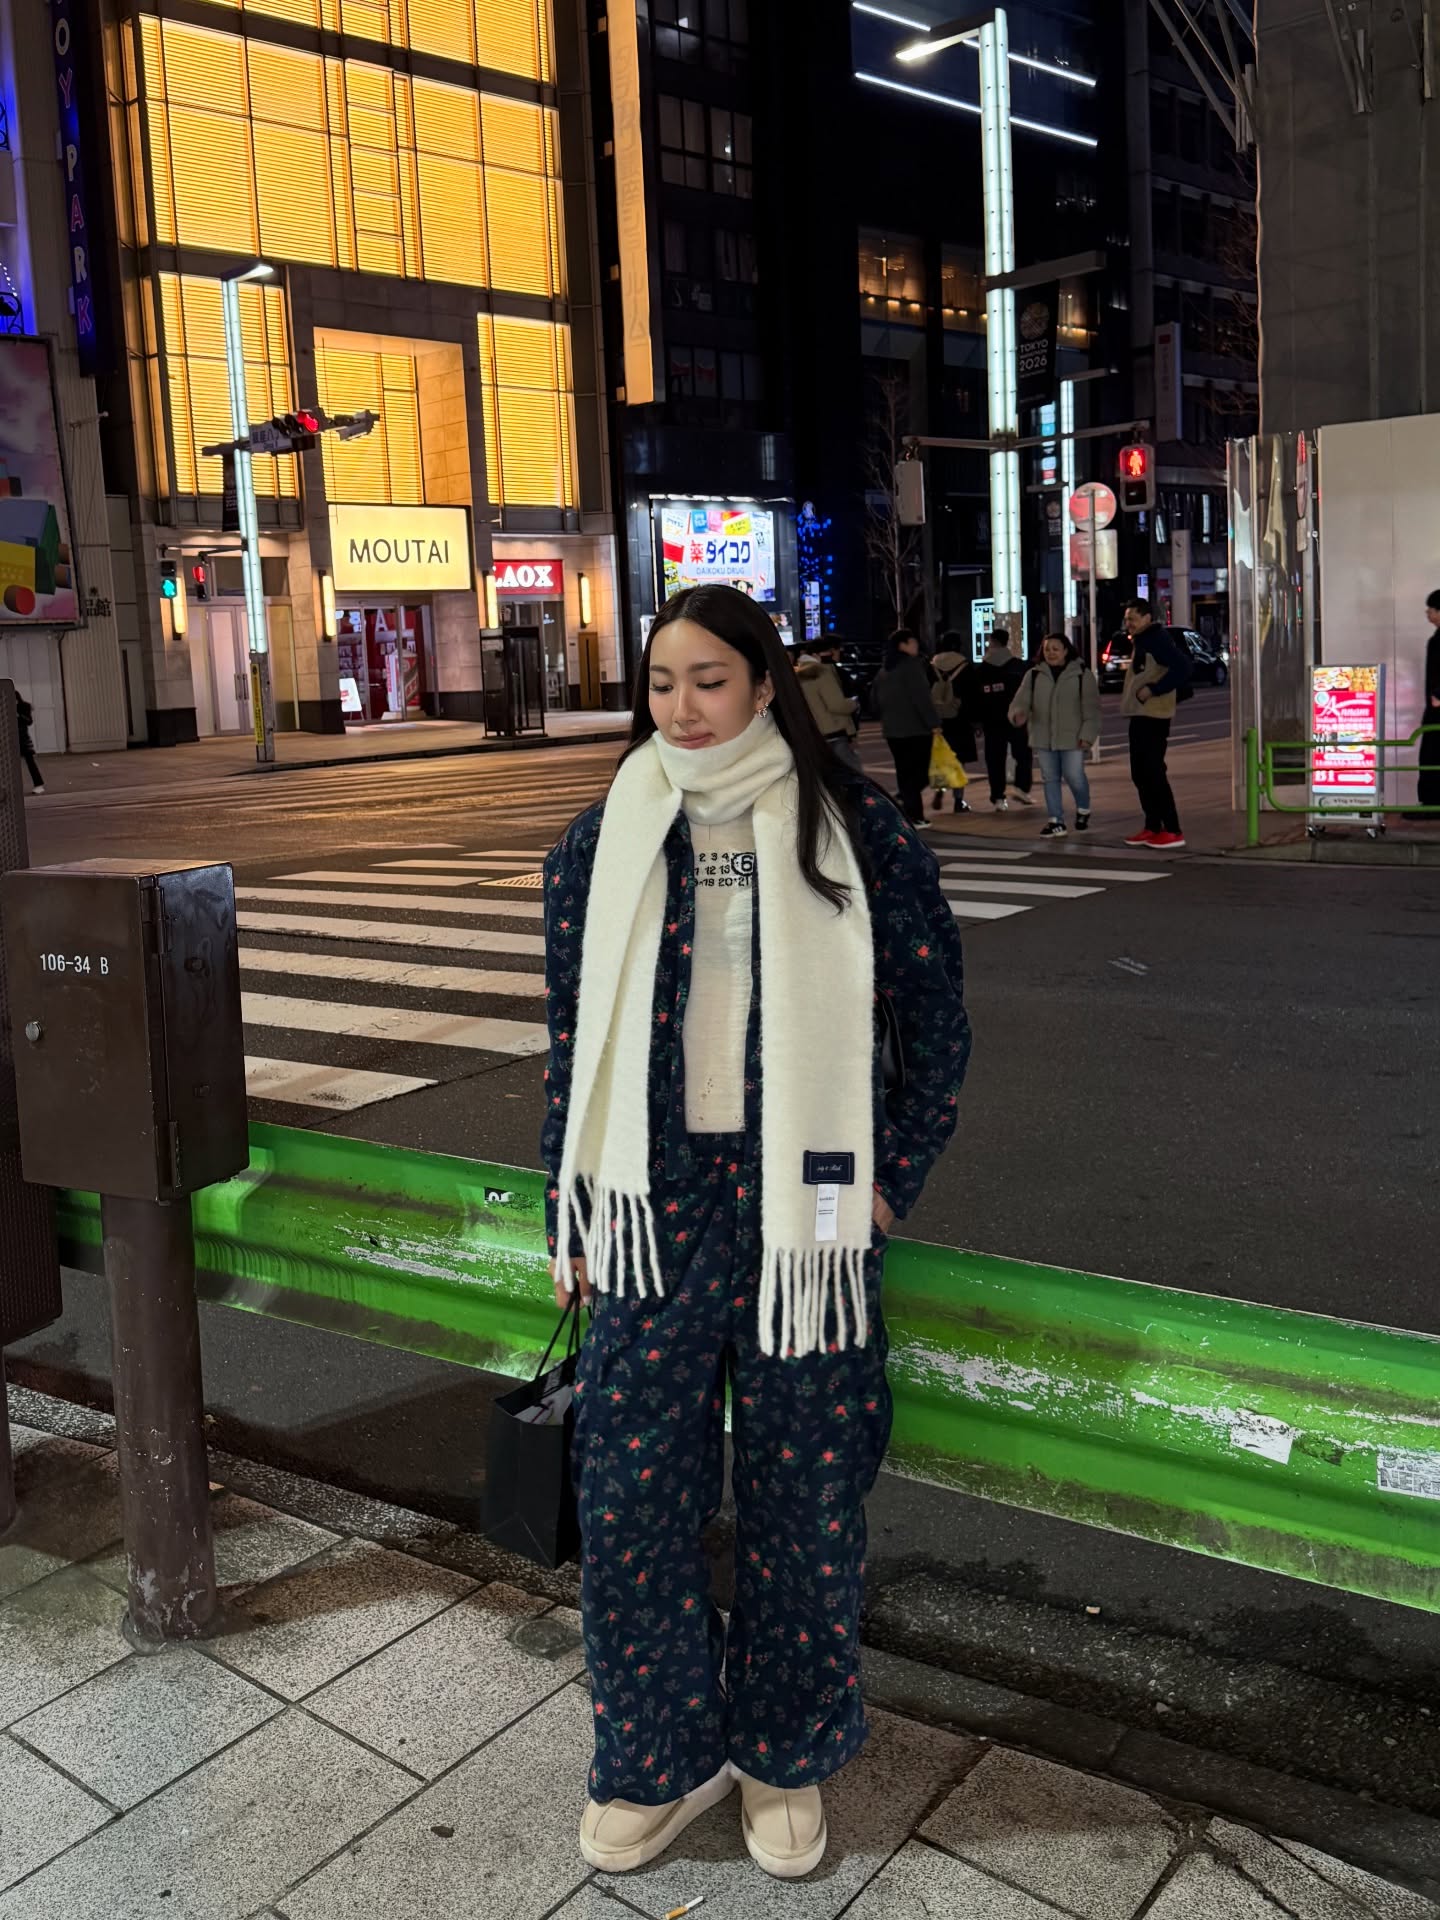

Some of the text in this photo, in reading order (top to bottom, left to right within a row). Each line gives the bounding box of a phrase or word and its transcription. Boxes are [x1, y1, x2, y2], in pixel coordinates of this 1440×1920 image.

[56, 0, 92, 334] OY PARK
[1020, 338, 1048, 353] TOKYO
[1019, 355, 1047, 371] 2026
[349, 538, 449, 564] MOUTAI
[696, 567, 745, 575] DAIKOKU DRUG
[699, 853, 706, 862] 2
[711, 852, 718, 861] 3
[741, 855, 754, 872] 6
[705, 866, 716, 875] 12
[719, 865, 730, 874] 13
[718, 877, 733, 887] 20
[40, 953, 109, 975] 106-34 B
